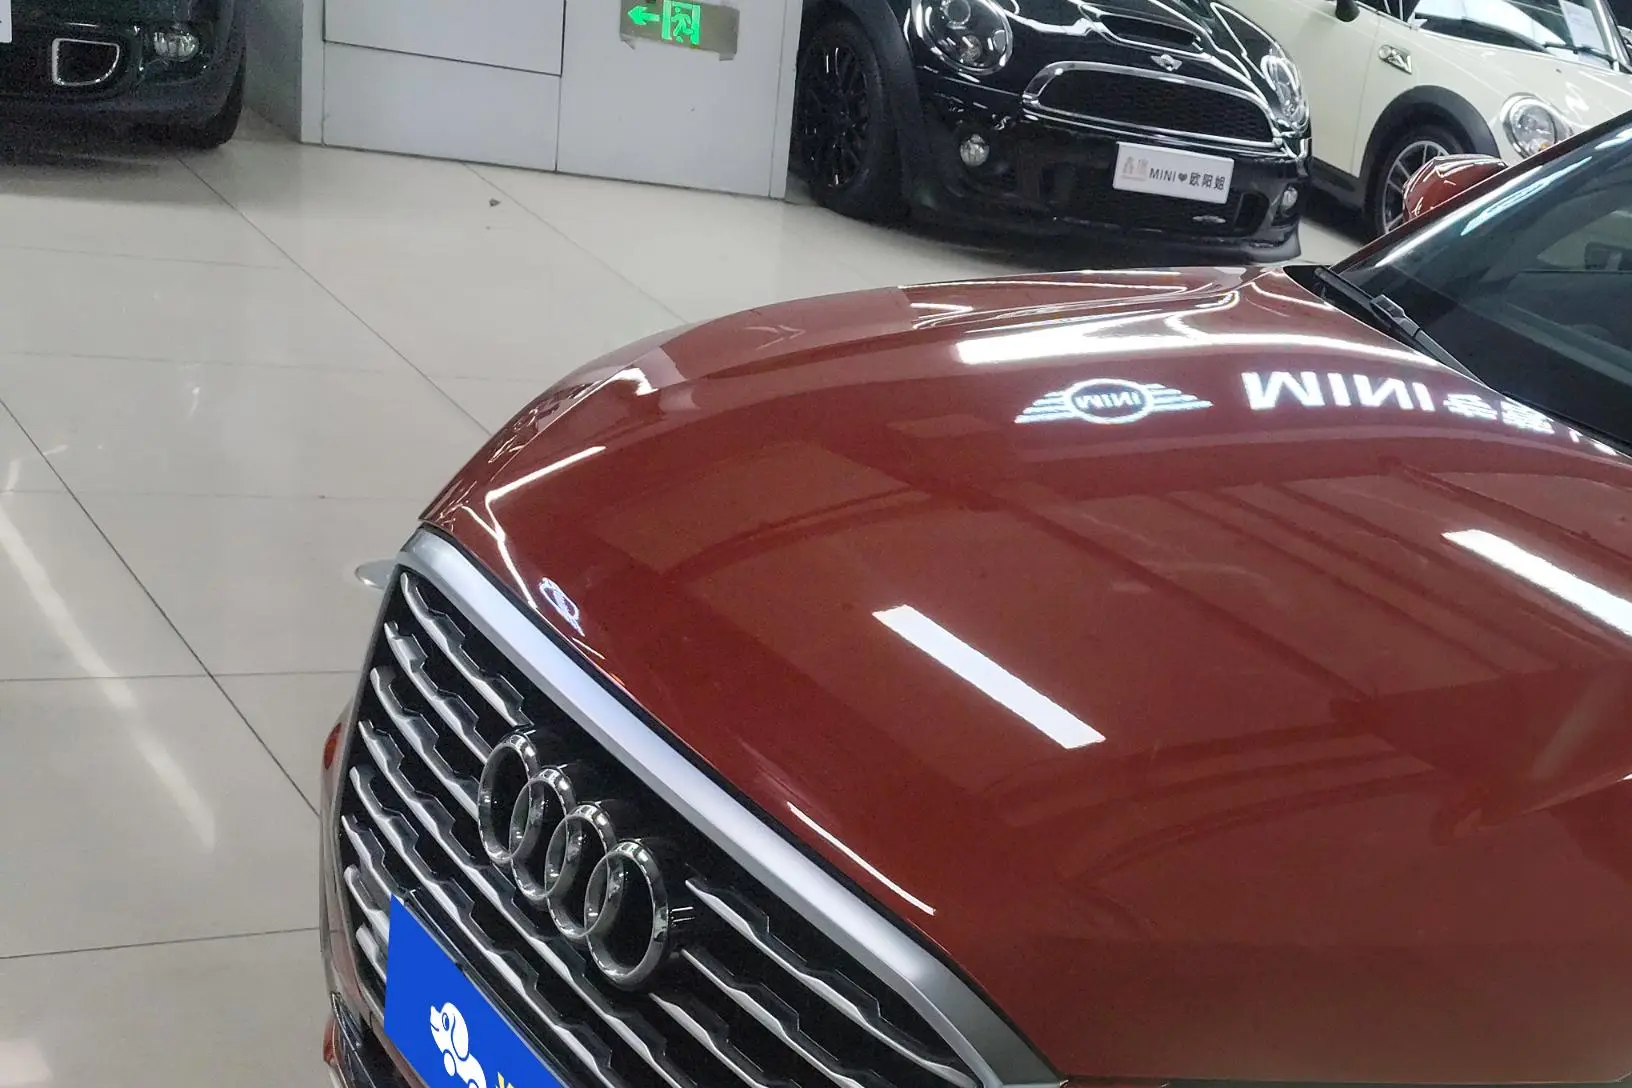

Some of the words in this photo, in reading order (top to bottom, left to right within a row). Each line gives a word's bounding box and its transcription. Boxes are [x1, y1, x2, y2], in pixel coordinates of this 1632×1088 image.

[1149, 167, 1177, 183] MINI
[1189, 172, 1226, 191] 欧阳姐
